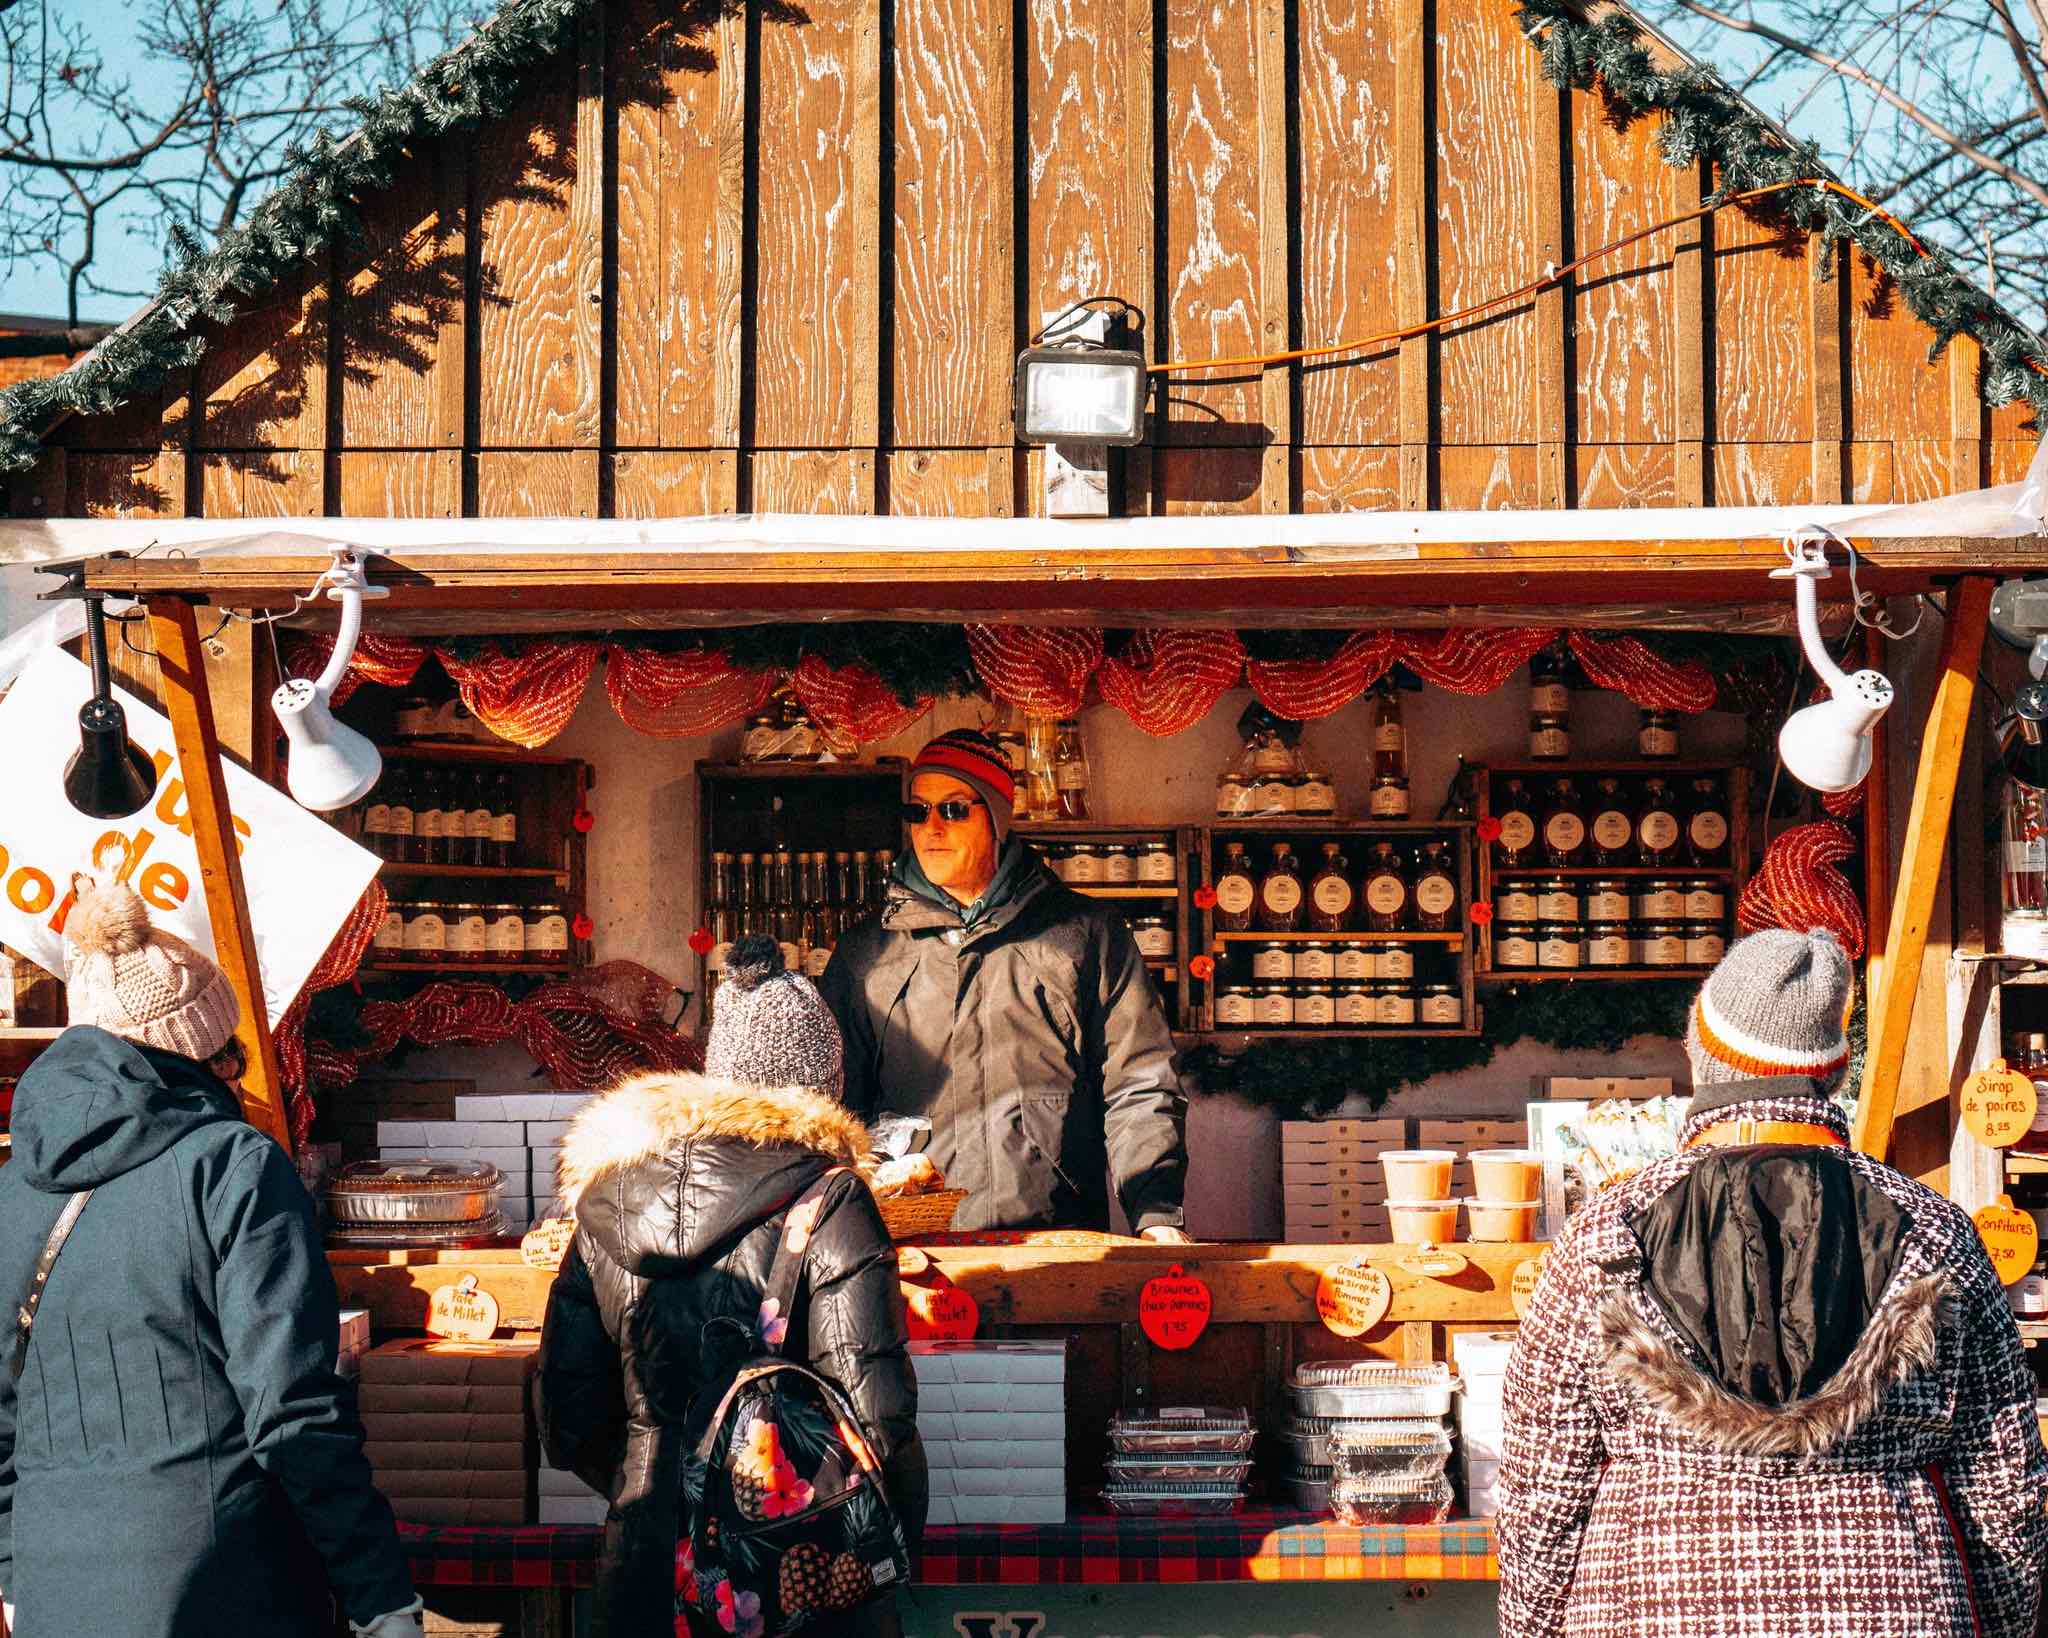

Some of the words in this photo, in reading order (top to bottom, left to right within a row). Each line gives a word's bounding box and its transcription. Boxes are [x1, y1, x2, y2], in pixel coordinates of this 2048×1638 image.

[92, 827, 189, 911] de
[1976, 1076, 2014, 1097] Sirop
[1966, 1097, 1979, 1112] de
[1986, 1101, 2026, 1118] poires
